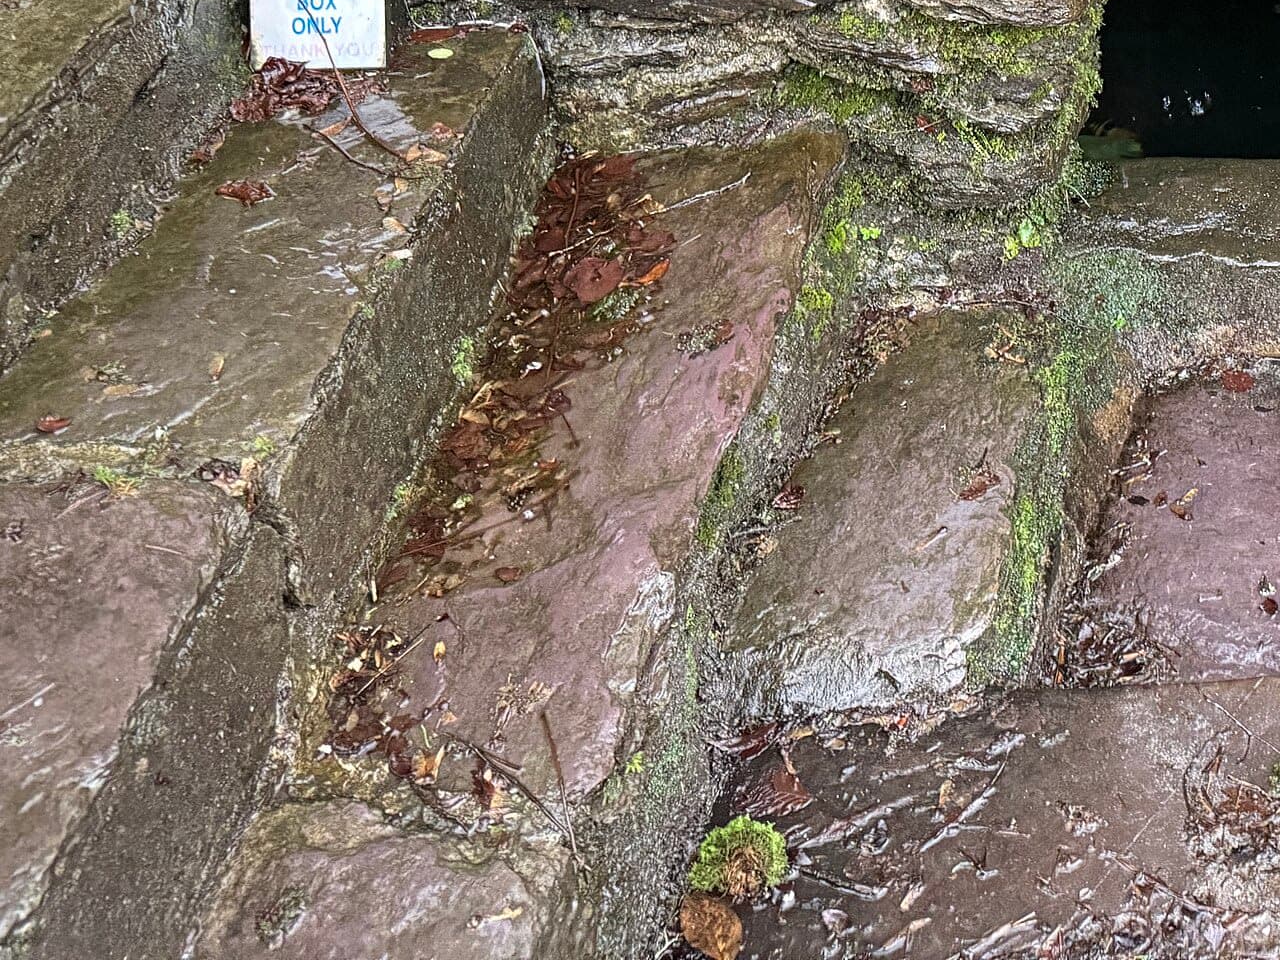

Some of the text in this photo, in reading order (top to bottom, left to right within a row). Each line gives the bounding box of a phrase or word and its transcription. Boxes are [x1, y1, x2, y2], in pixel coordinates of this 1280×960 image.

[291, 16, 342, 35] ONLY
[264, 42, 374, 57] THANK YOU
